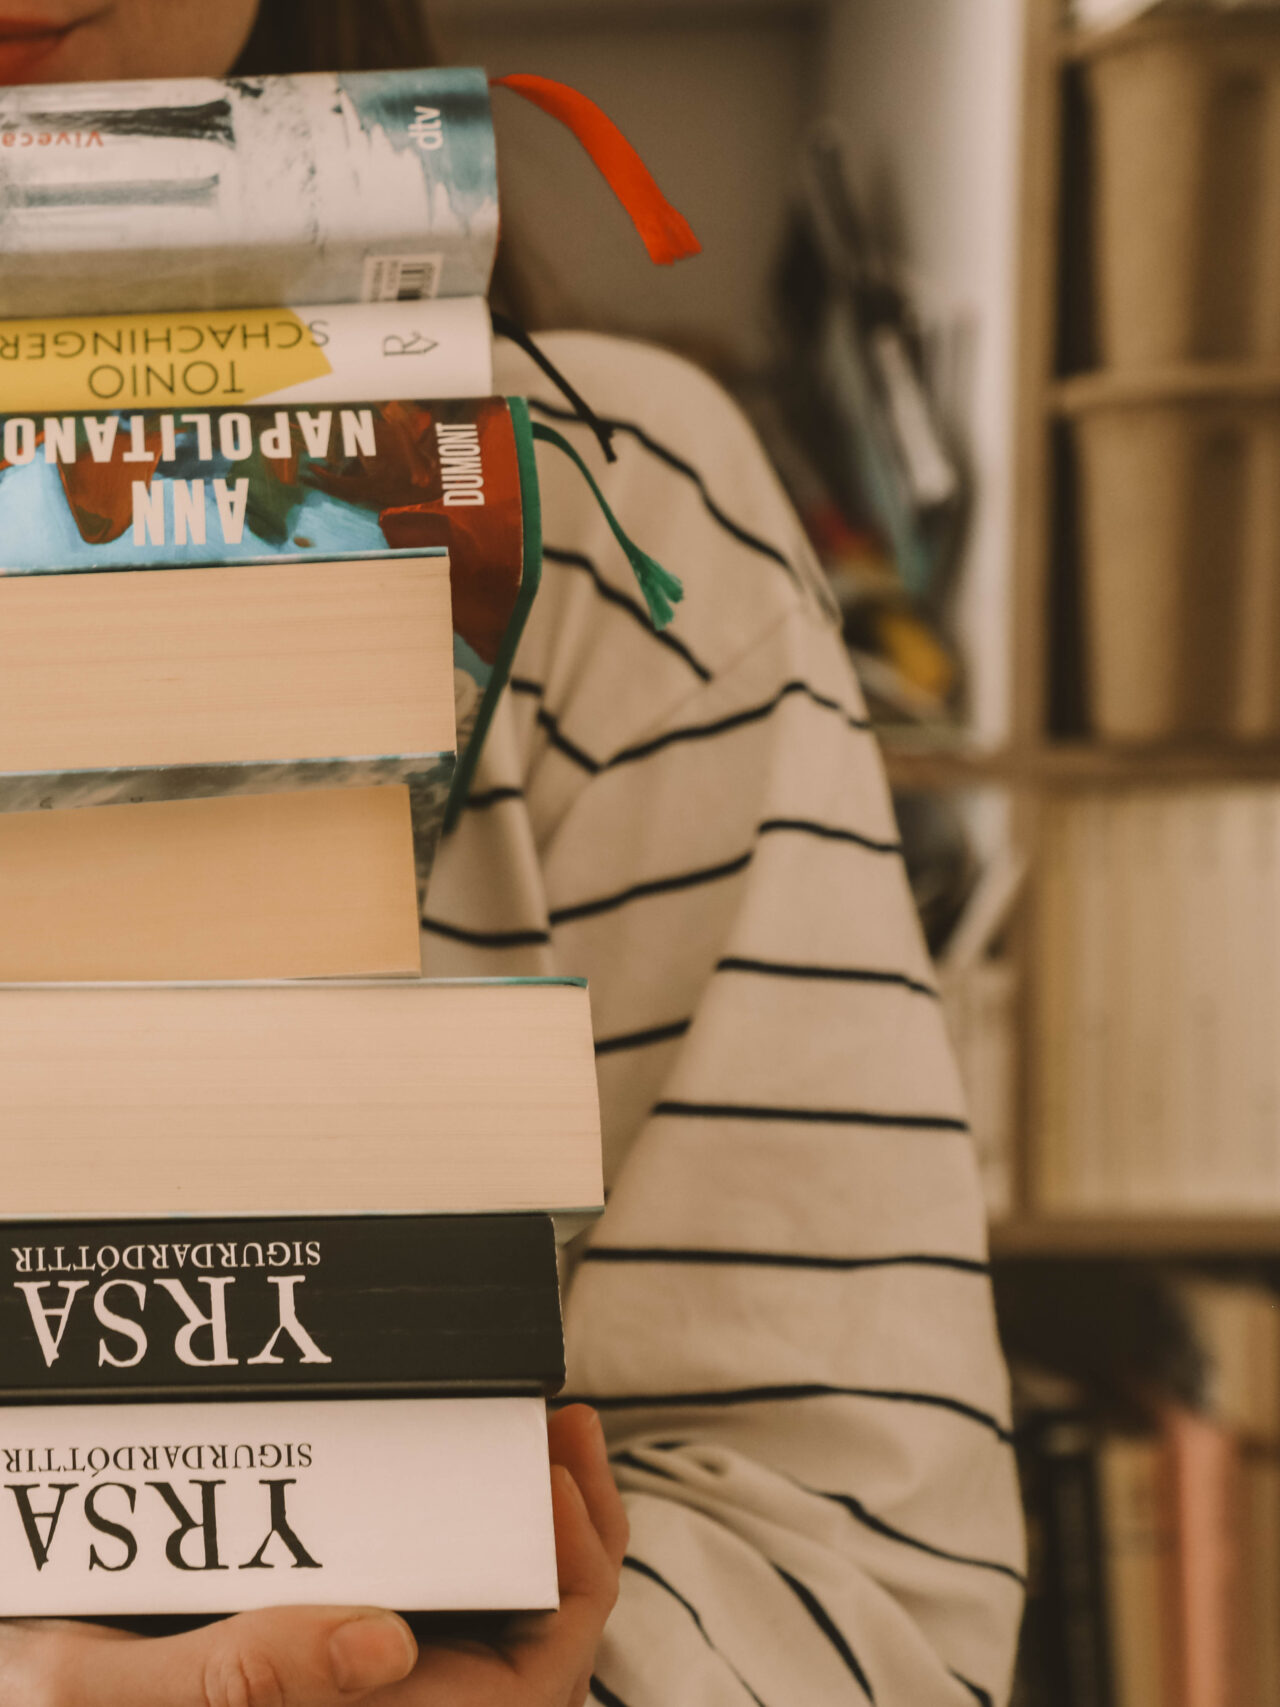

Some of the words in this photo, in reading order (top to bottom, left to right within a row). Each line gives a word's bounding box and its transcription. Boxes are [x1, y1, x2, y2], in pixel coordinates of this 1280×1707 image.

[1, 131, 104, 148] Viveca
[408, 105, 443, 150] dtv
[88, 361, 244, 399] TONIO
[4, 409, 377, 464] NAPOLITANO
[435, 423, 485, 506] DUMONT
[132, 477, 249, 546] ANN
[12, 1241, 320, 1276] SIGURDARDÓTTIR
[13, 1275, 332, 1367] YRSA
[1, 1443, 312, 1477] SIGURDARDÓTTIR
[4, 1479, 323, 1571] YRSA
